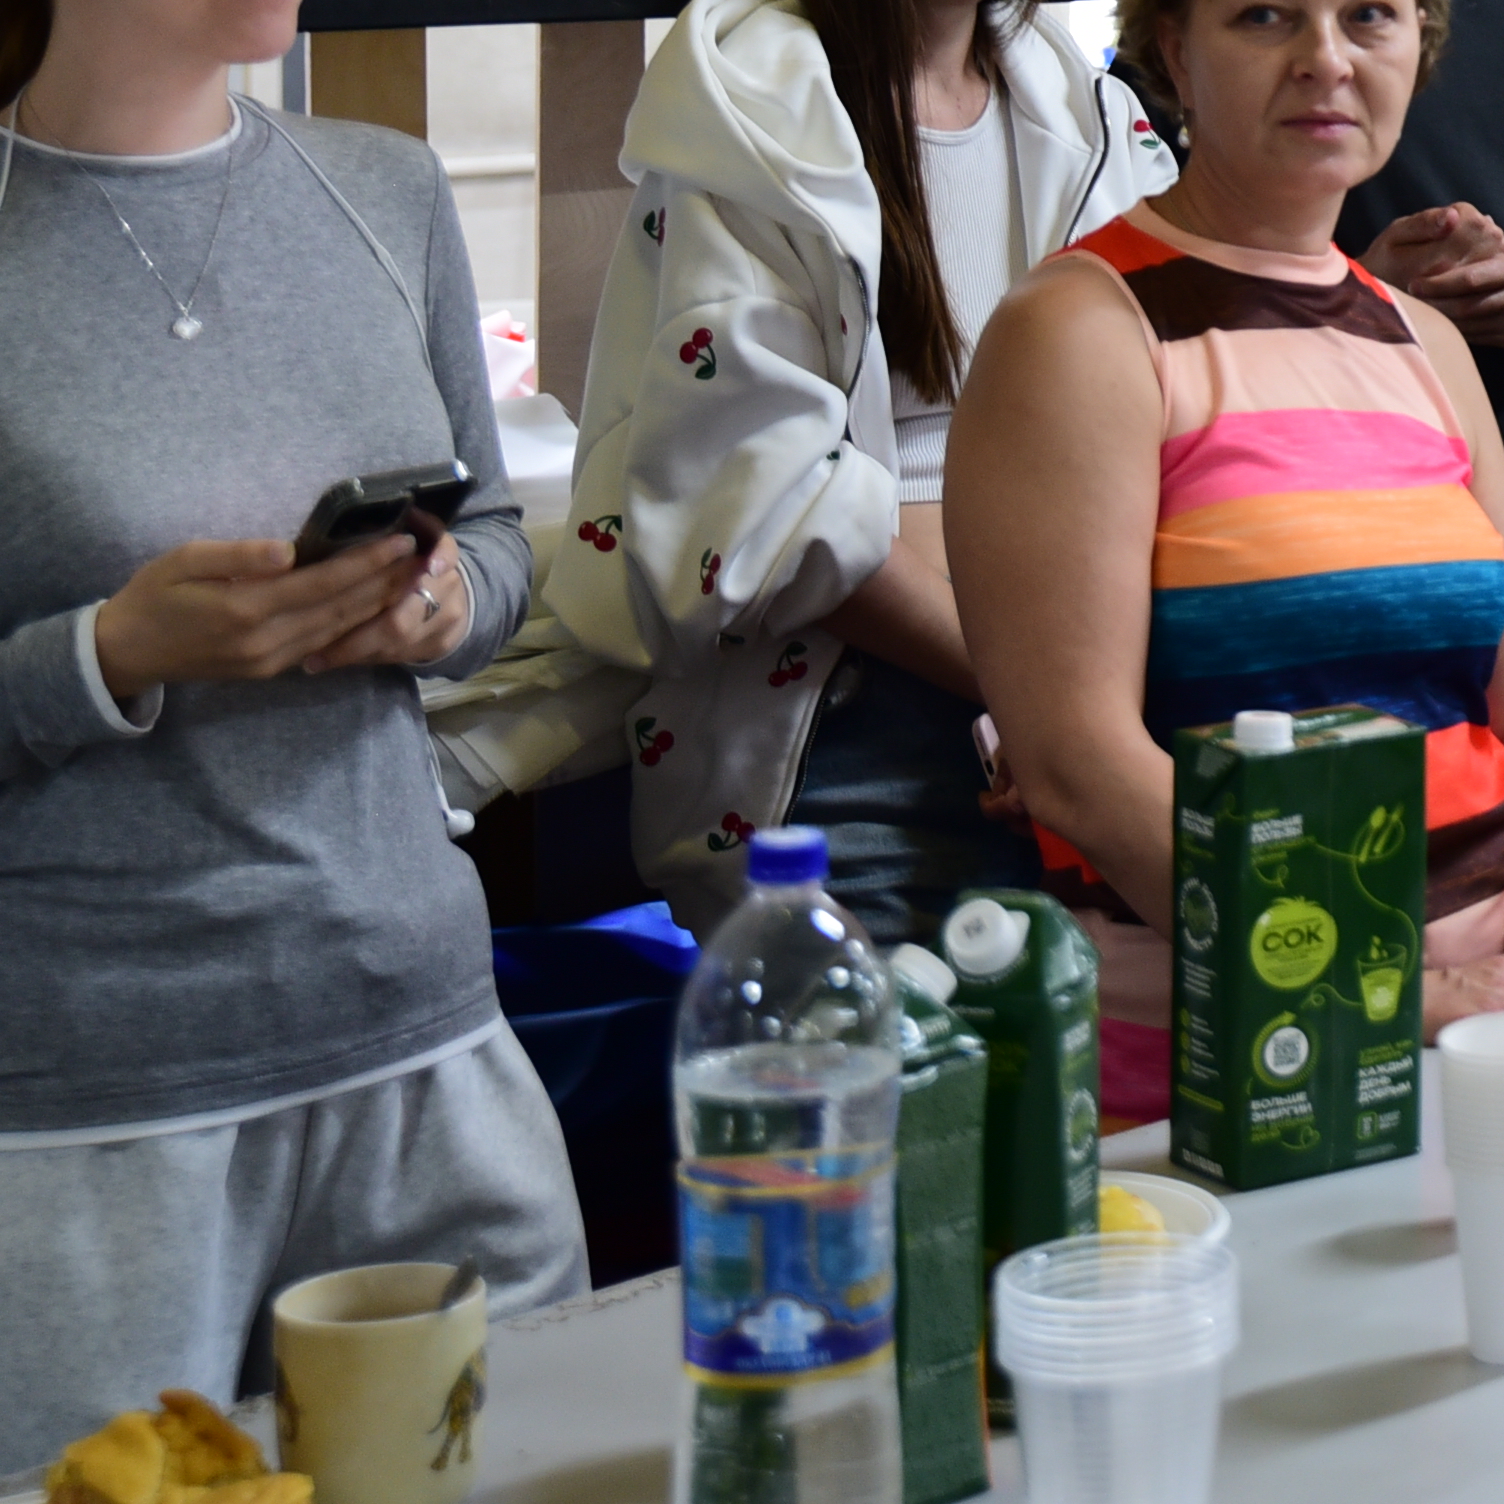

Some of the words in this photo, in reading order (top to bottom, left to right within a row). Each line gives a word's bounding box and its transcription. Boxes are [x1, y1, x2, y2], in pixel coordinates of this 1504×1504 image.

[1262, 924, 1324, 953] СОК
[1250, 1091, 1307, 1110] БОЛЬШЕ
[1250, 1102, 1313, 1123] ЭНЕРГИИ
